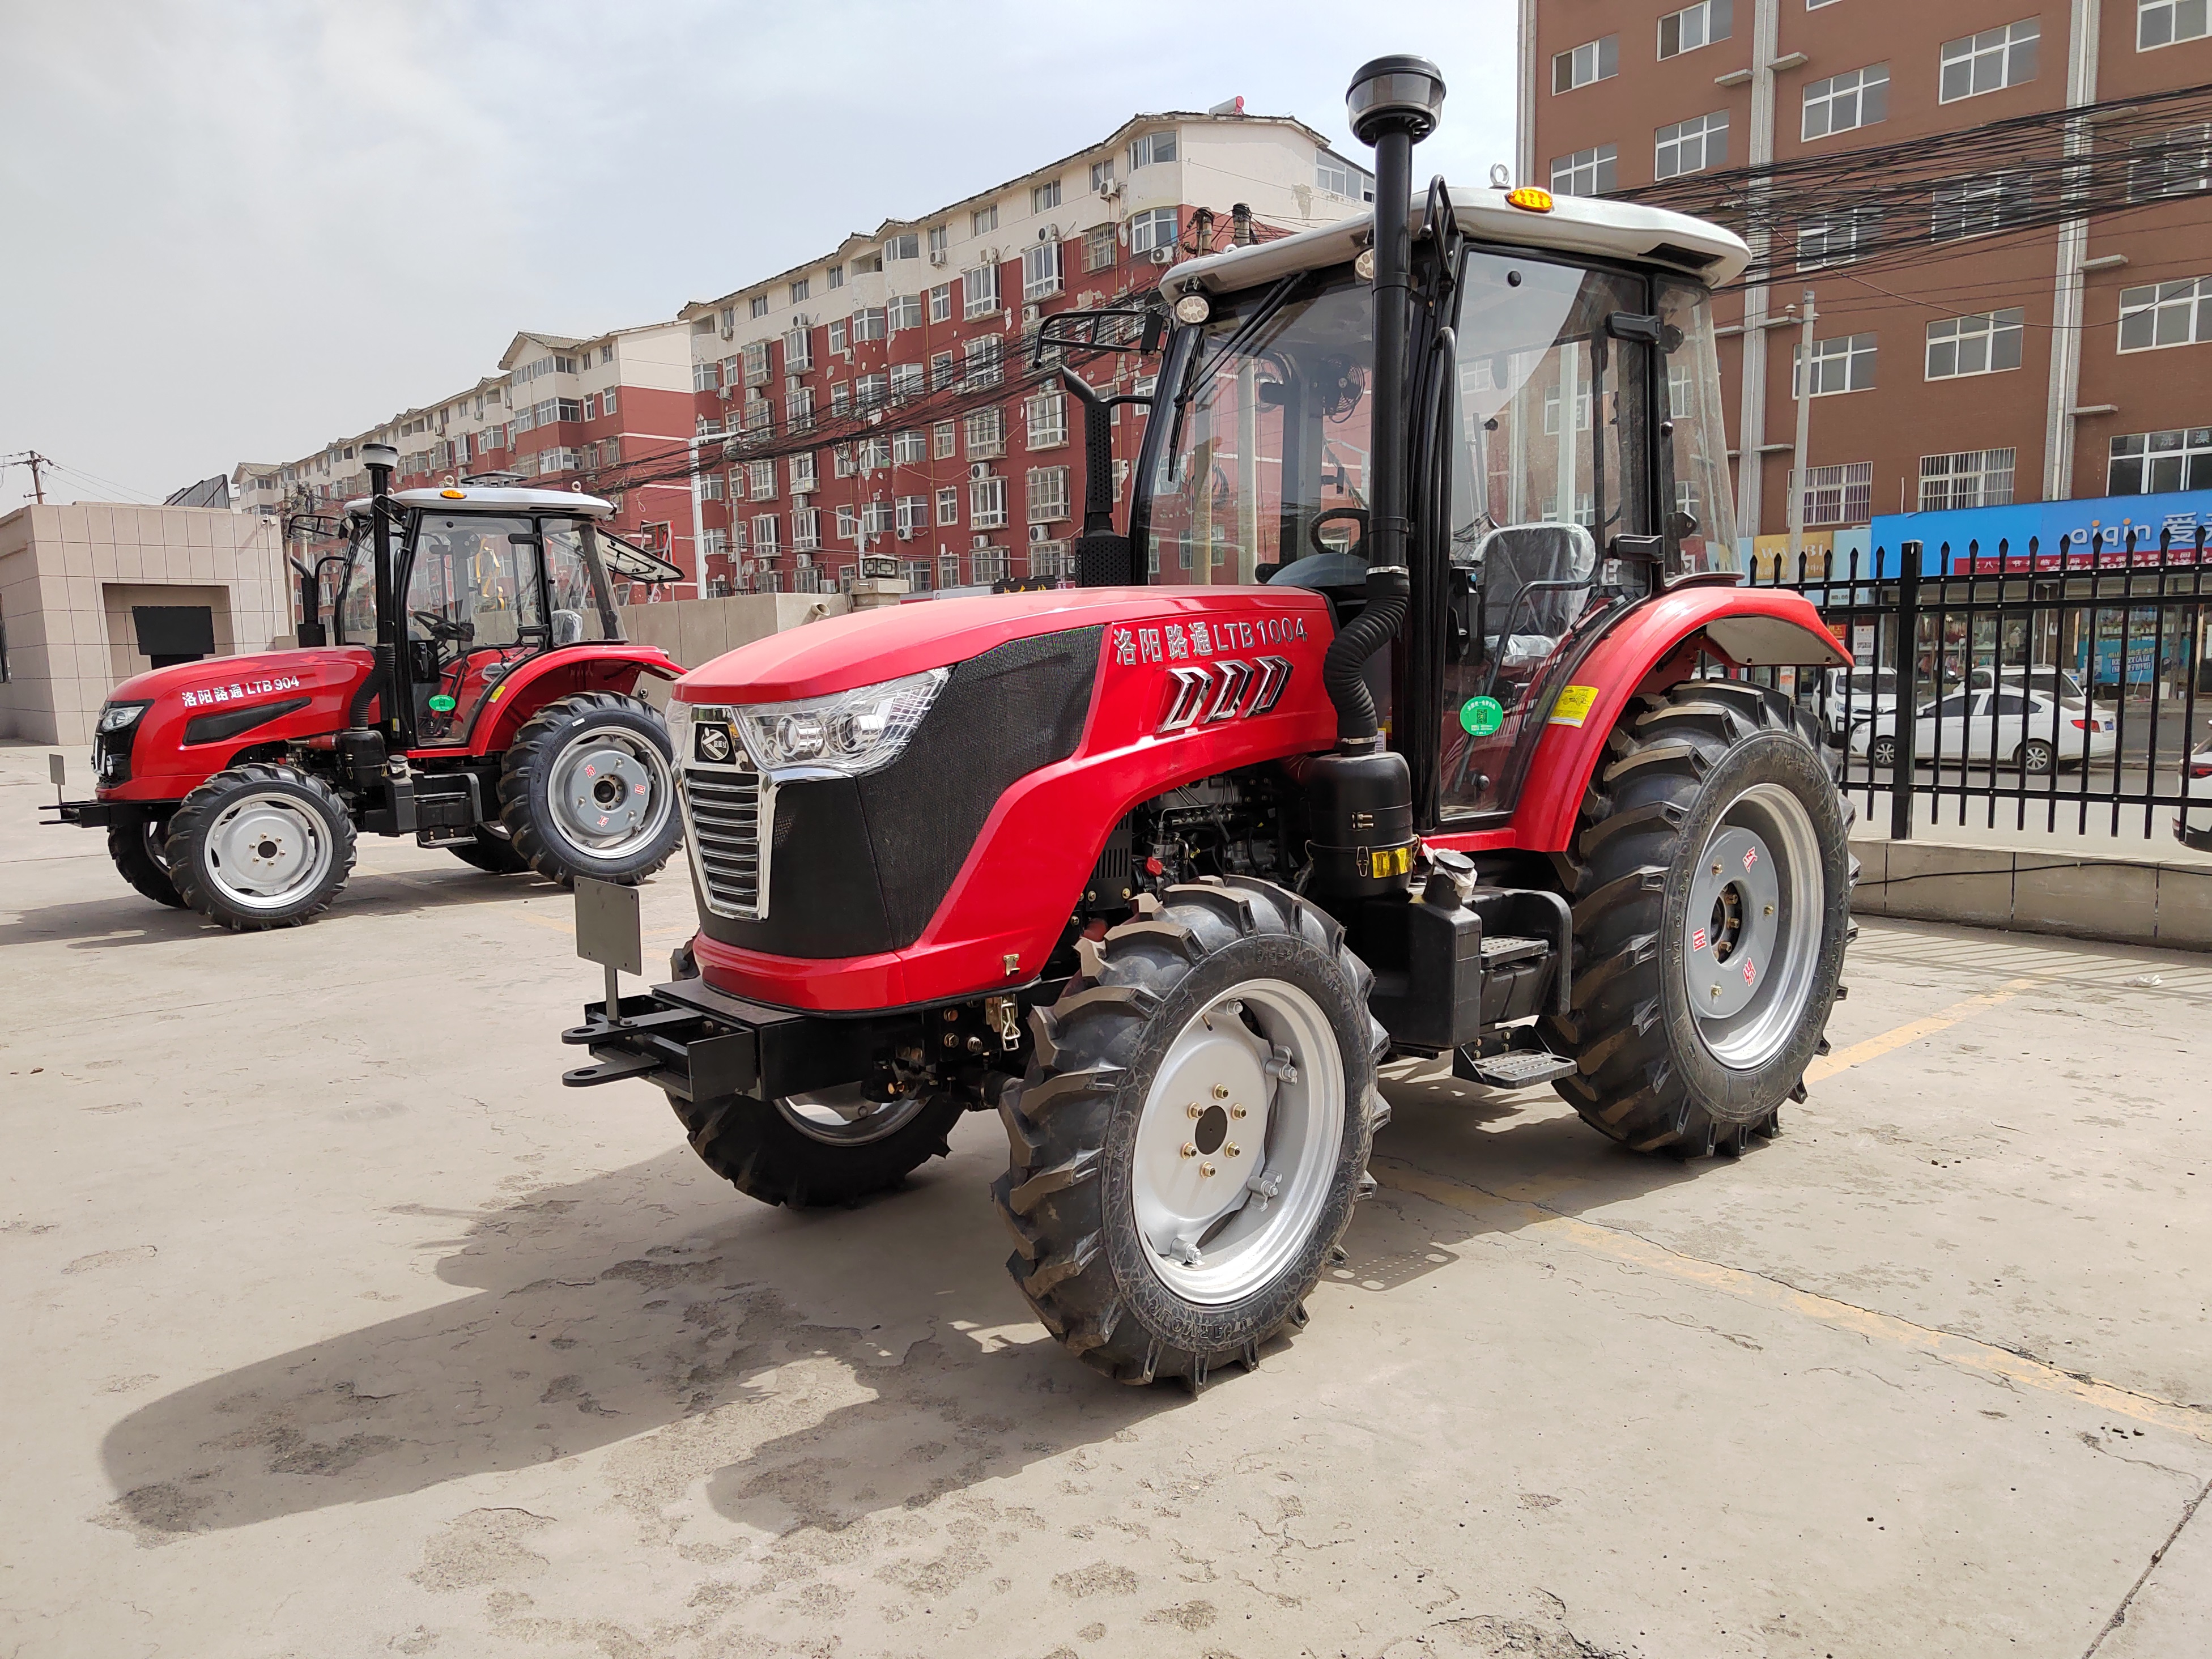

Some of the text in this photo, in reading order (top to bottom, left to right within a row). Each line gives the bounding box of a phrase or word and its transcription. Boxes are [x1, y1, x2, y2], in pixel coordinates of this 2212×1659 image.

[2070, 518, 2151, 546] aiqin
[1113, 618, 1308, 666] 洛阳路通 LTB1004
[182, 683, 244, 707] 洛阳路通
